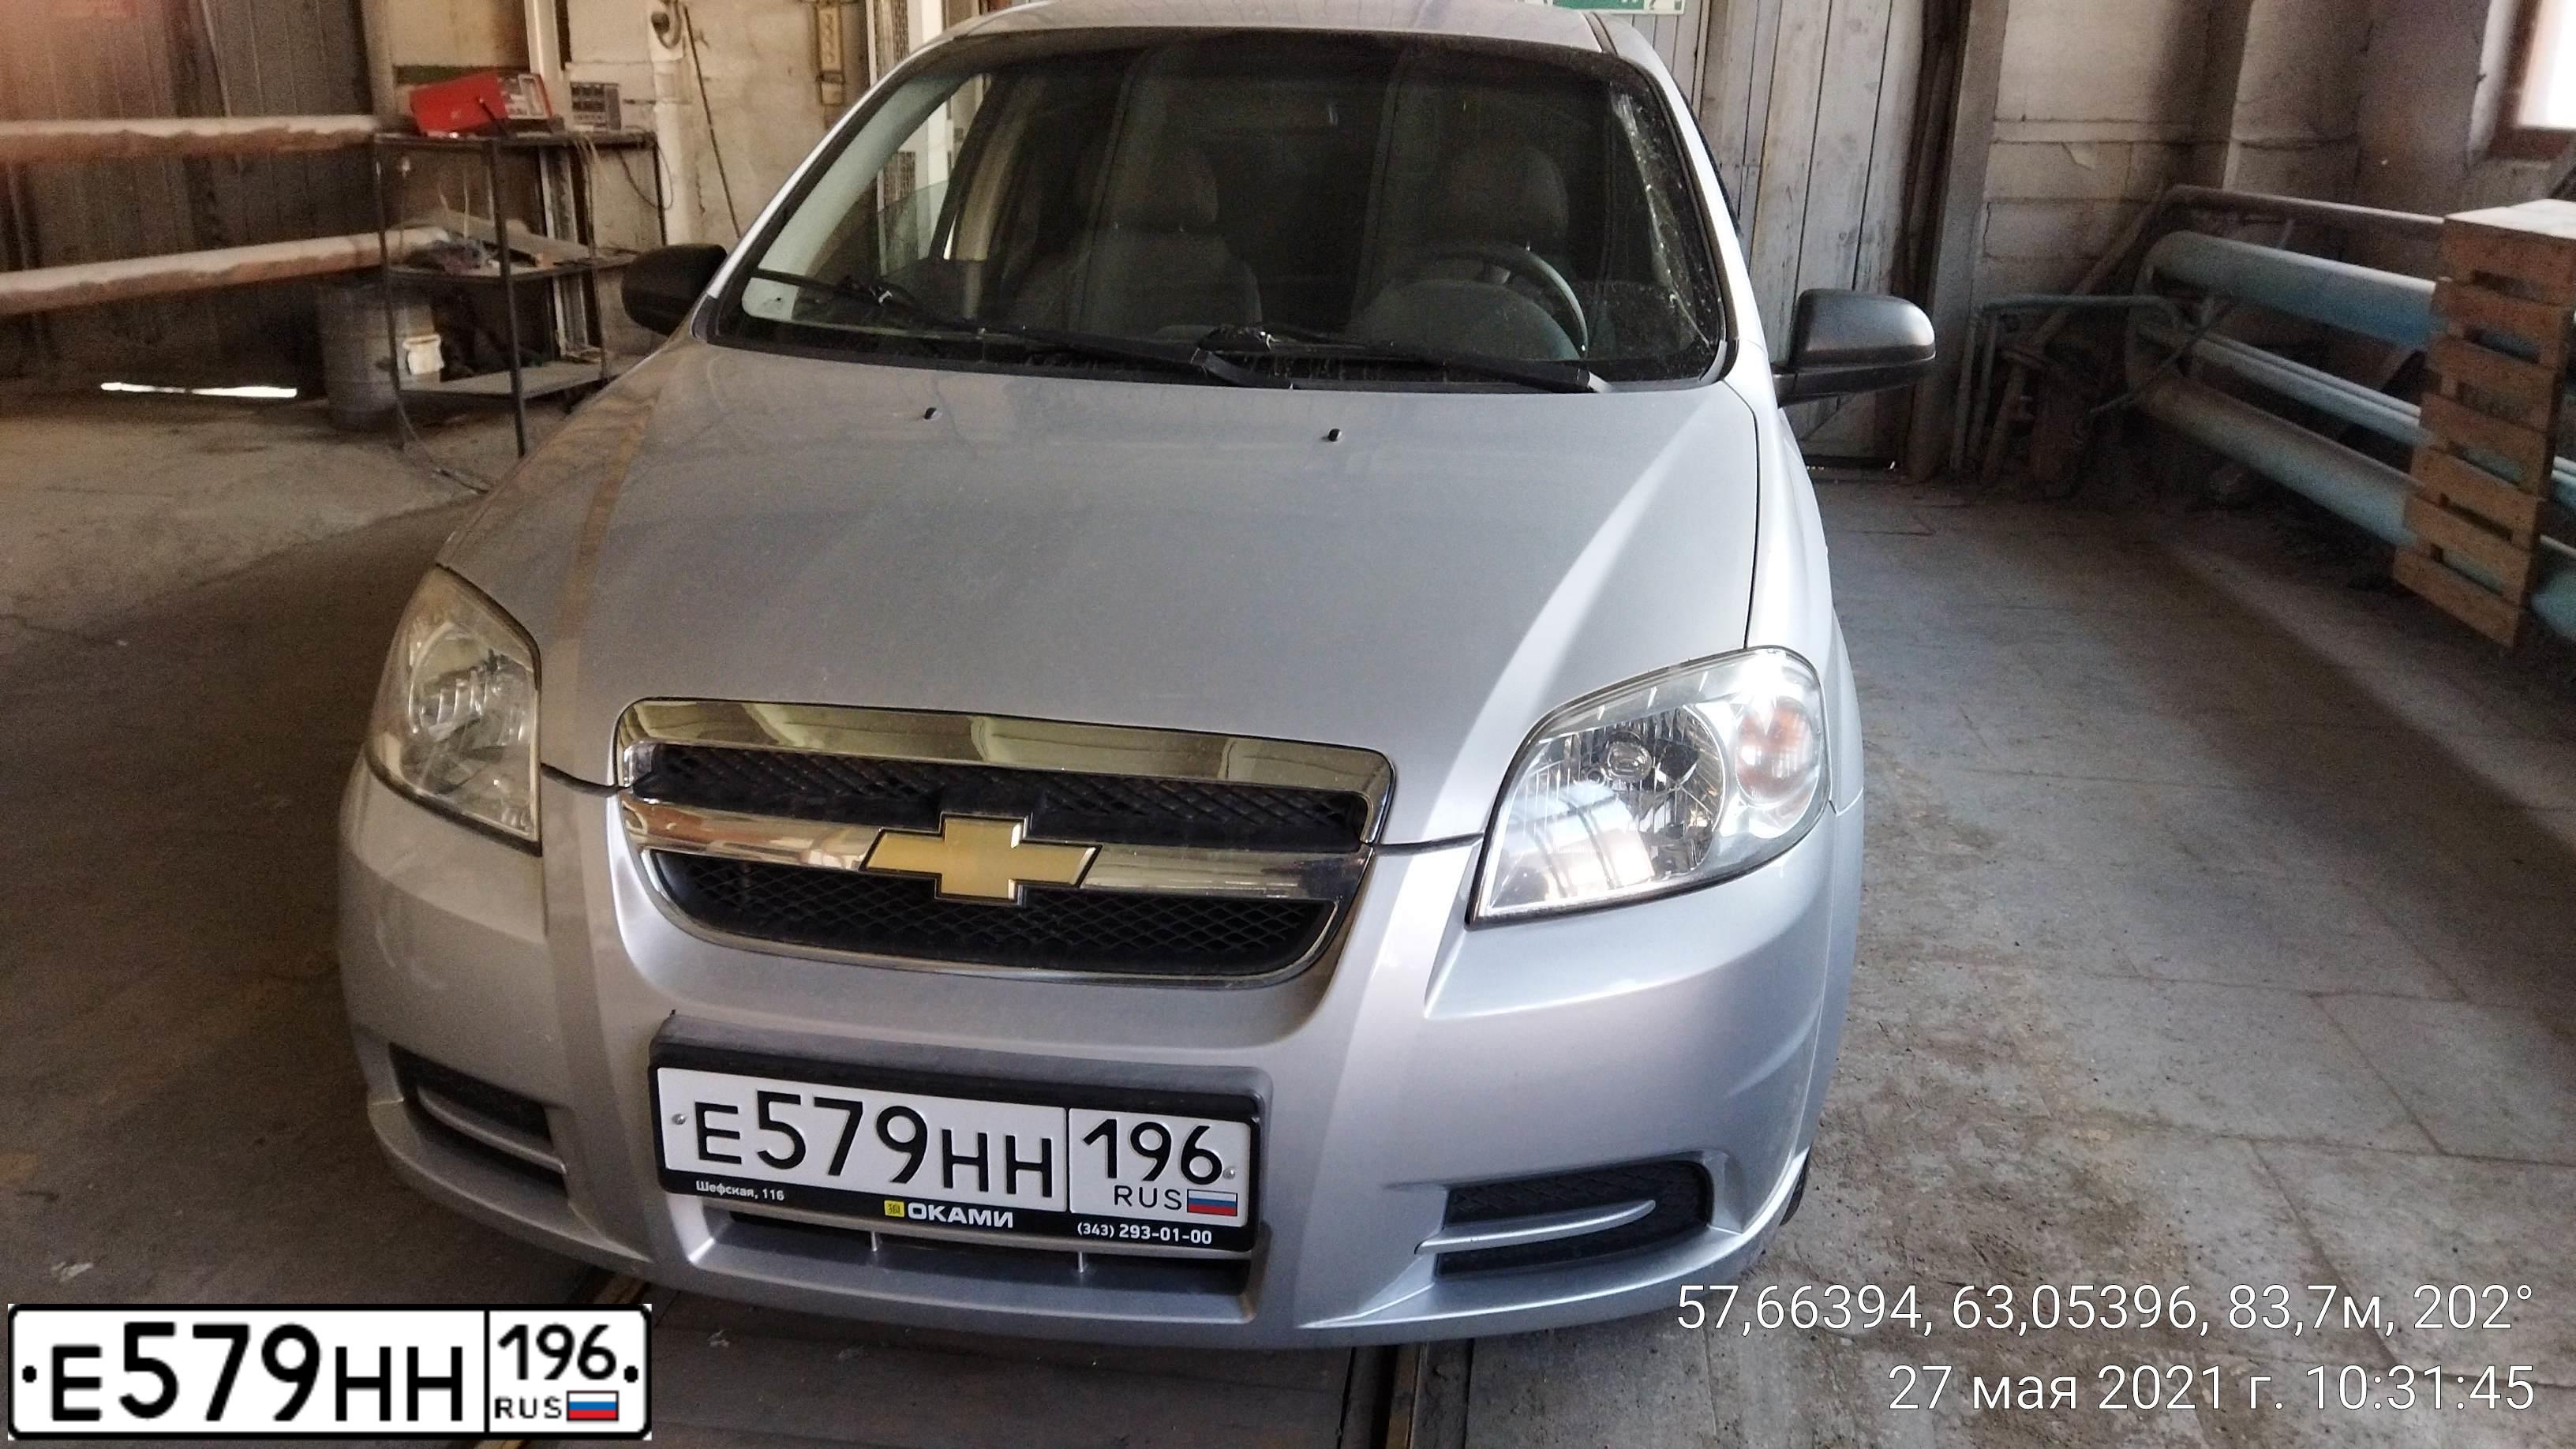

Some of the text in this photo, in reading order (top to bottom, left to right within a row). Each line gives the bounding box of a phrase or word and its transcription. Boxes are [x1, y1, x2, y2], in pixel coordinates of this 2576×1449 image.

[1082, 1118, 1224, 1185] 196
[695, 1180, 758, 1200] Шефская,
[1114, 1185, 1182, 1211] RUS
[908, 1202, 1014, 1229] ОКАМИ
[1077, 1222, 1213, 1245] (343) 293-01-00
